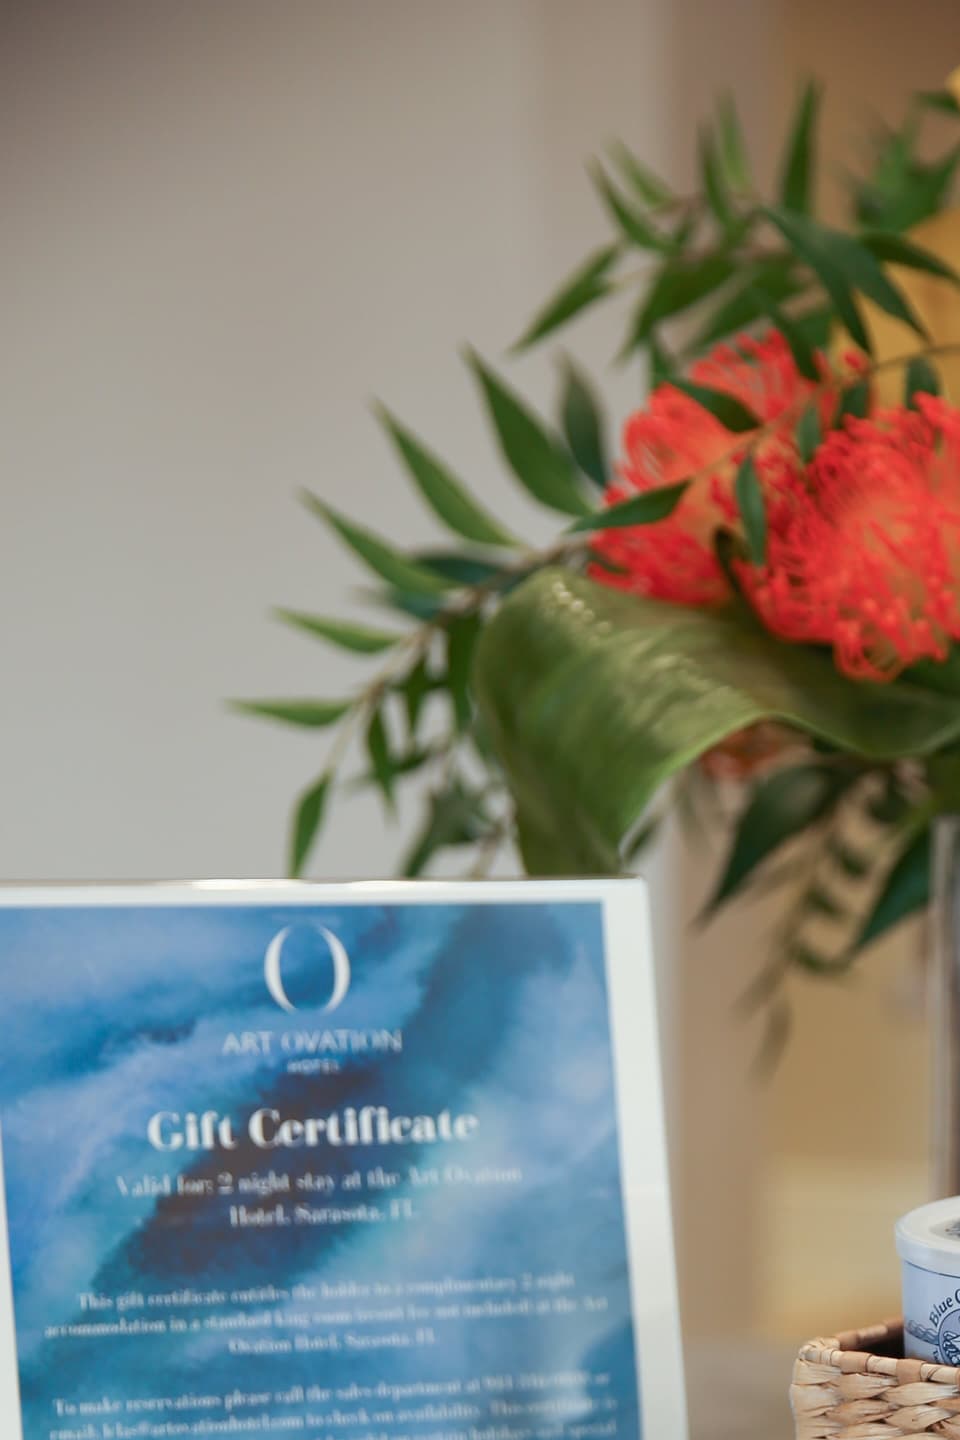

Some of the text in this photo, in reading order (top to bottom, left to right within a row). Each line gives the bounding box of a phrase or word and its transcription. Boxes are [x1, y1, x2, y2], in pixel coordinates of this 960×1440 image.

[222, 1027, 402, 1057] ART OVATION
[147, 1102, 480, 1150] Gift Certificate
[238, 1170, 291, 1197] night
[929, 1297, 953, 1329] Blue
